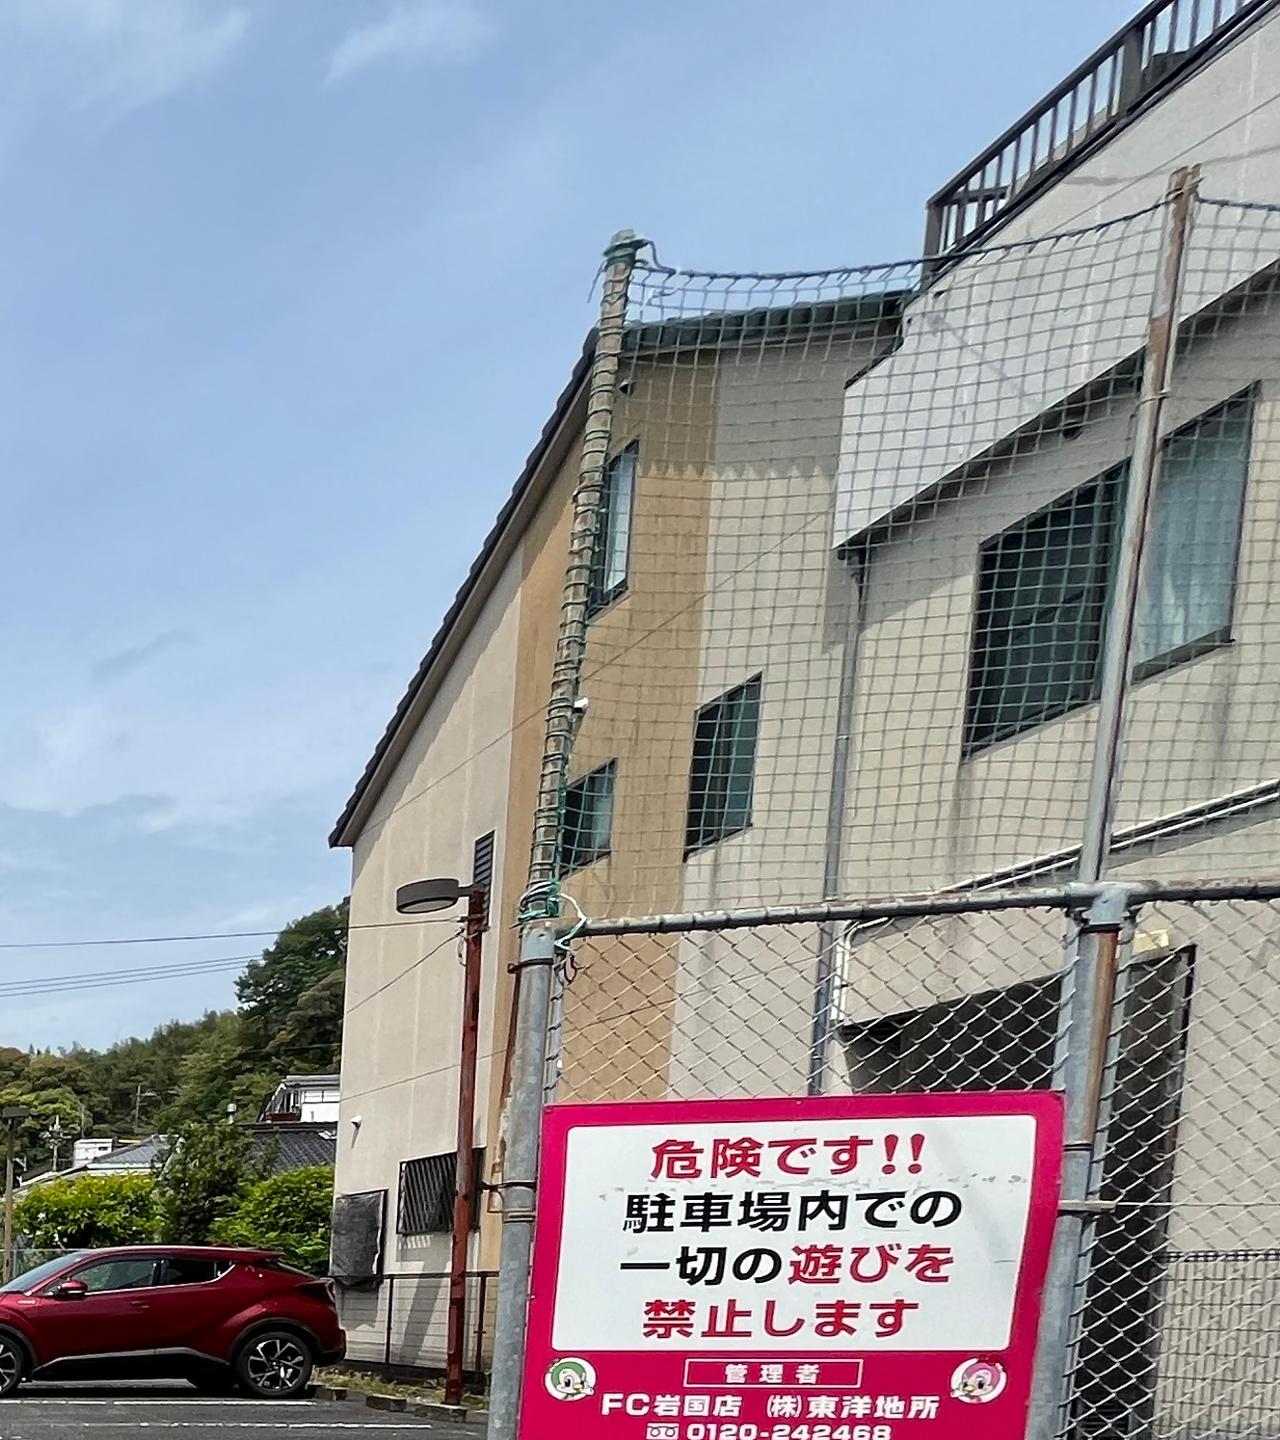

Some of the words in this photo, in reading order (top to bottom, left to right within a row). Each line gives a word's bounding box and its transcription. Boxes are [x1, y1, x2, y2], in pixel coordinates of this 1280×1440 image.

[650, 1133, 926, 1179] 危険です!!
[622, 1189, 963, 1233] 駐車場内での
[620, 1243, 955, 1286] 一切の遊びを
[642, 1299, 920, 1340] 禁止します
[724, 1363, 821, 1385] 管理者
[601, 1393, 743, 1418] FC岩国店
